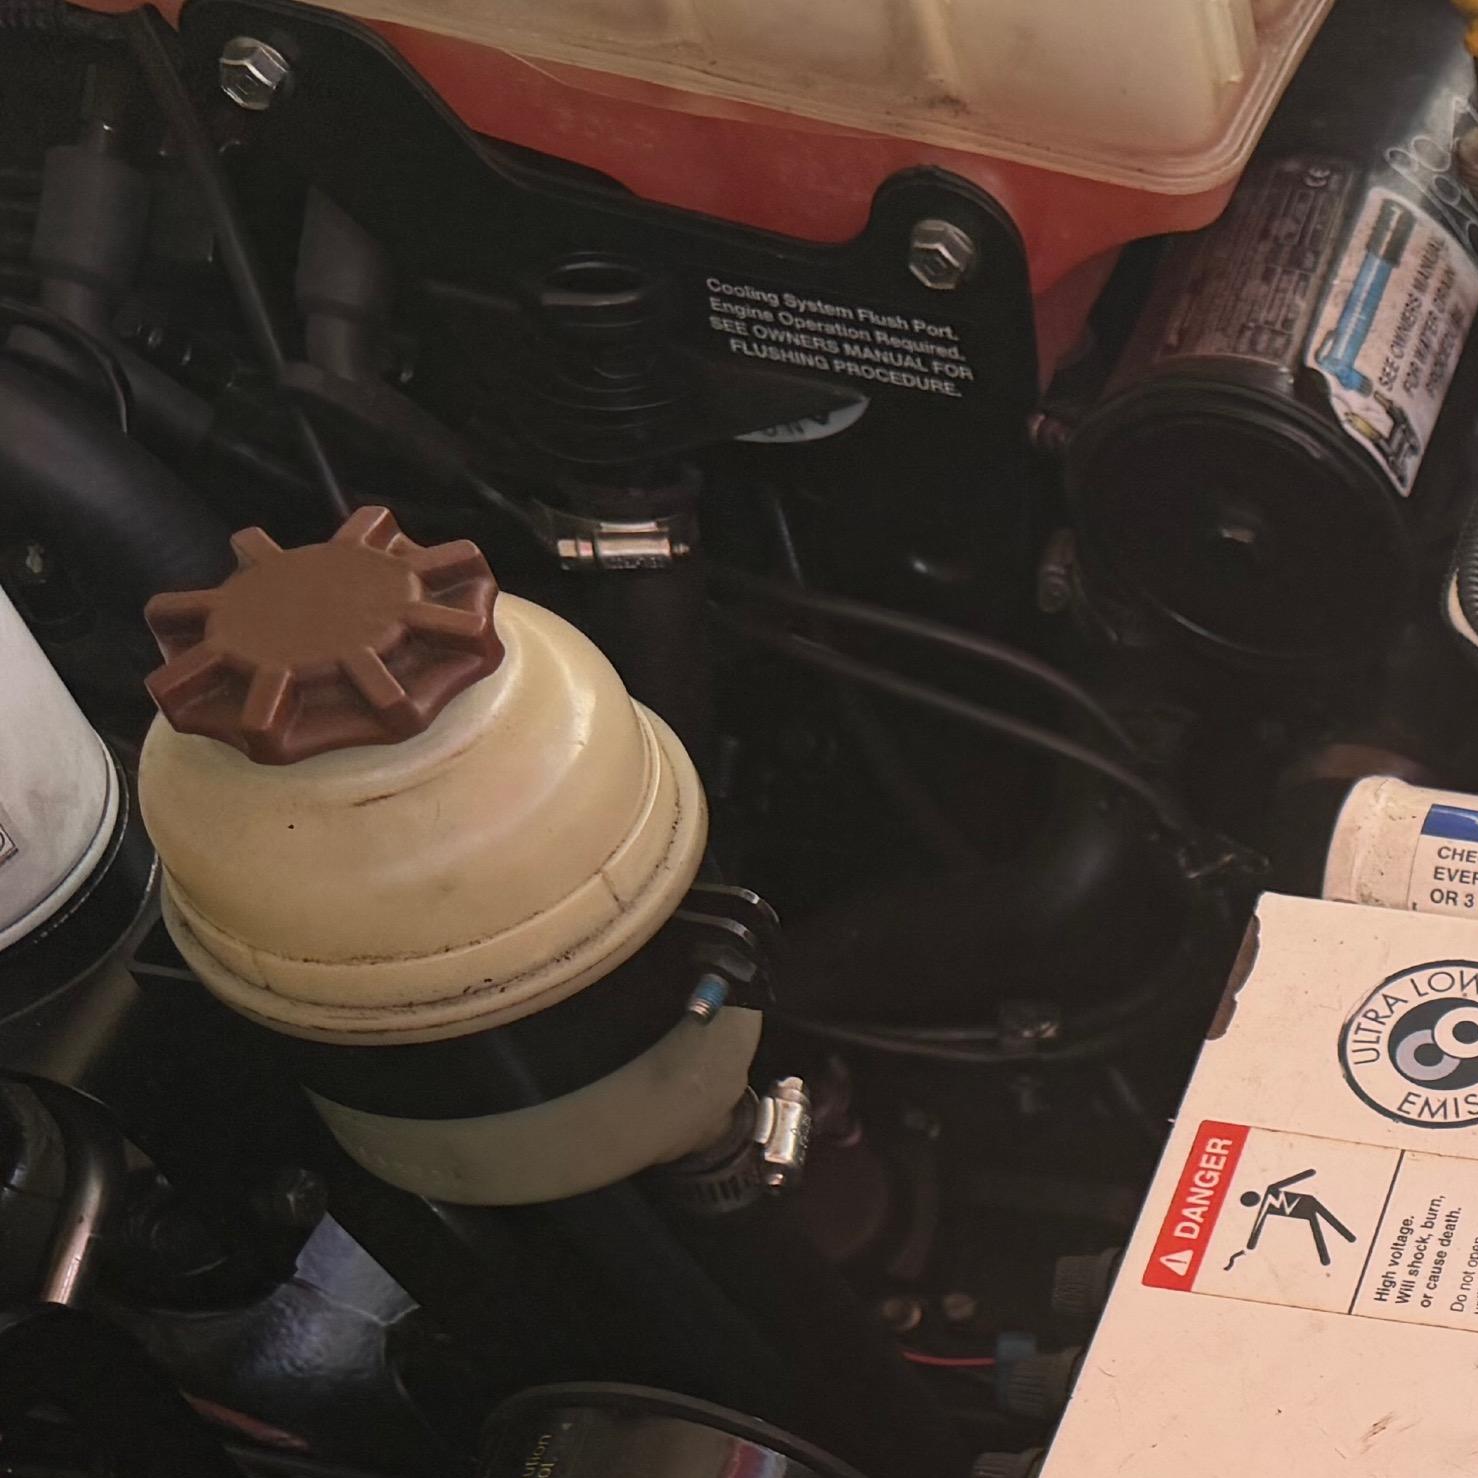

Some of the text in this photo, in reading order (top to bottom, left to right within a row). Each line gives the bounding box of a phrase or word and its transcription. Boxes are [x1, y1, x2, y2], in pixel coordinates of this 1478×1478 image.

[706, 277, 960, 341] Cooling System Flush Port.
[709, 297, 967, 361] Engine Operation Required.
[709, 316, 974, 381] SEE OWNERS MANUAL FOR
[730, 338, 830, 370] FLUSHING
[1428, 887, 1460, 906] OR
[1462, 893, 1476, 909] 3
[1352, 993, 1409, 1065] ULTRA
[1170, 1135, 1235, 1241] DANGER
[1372, 1213, 1418, 1303] High voltage.
[1394, 1193, 1446, 1306] Will shock, burn,
[1417, 1205, 1464, 1309] or cause death.
[1456, 1269, 1477, 1291] not
[1448, 1292, 1469, 1313] Do
